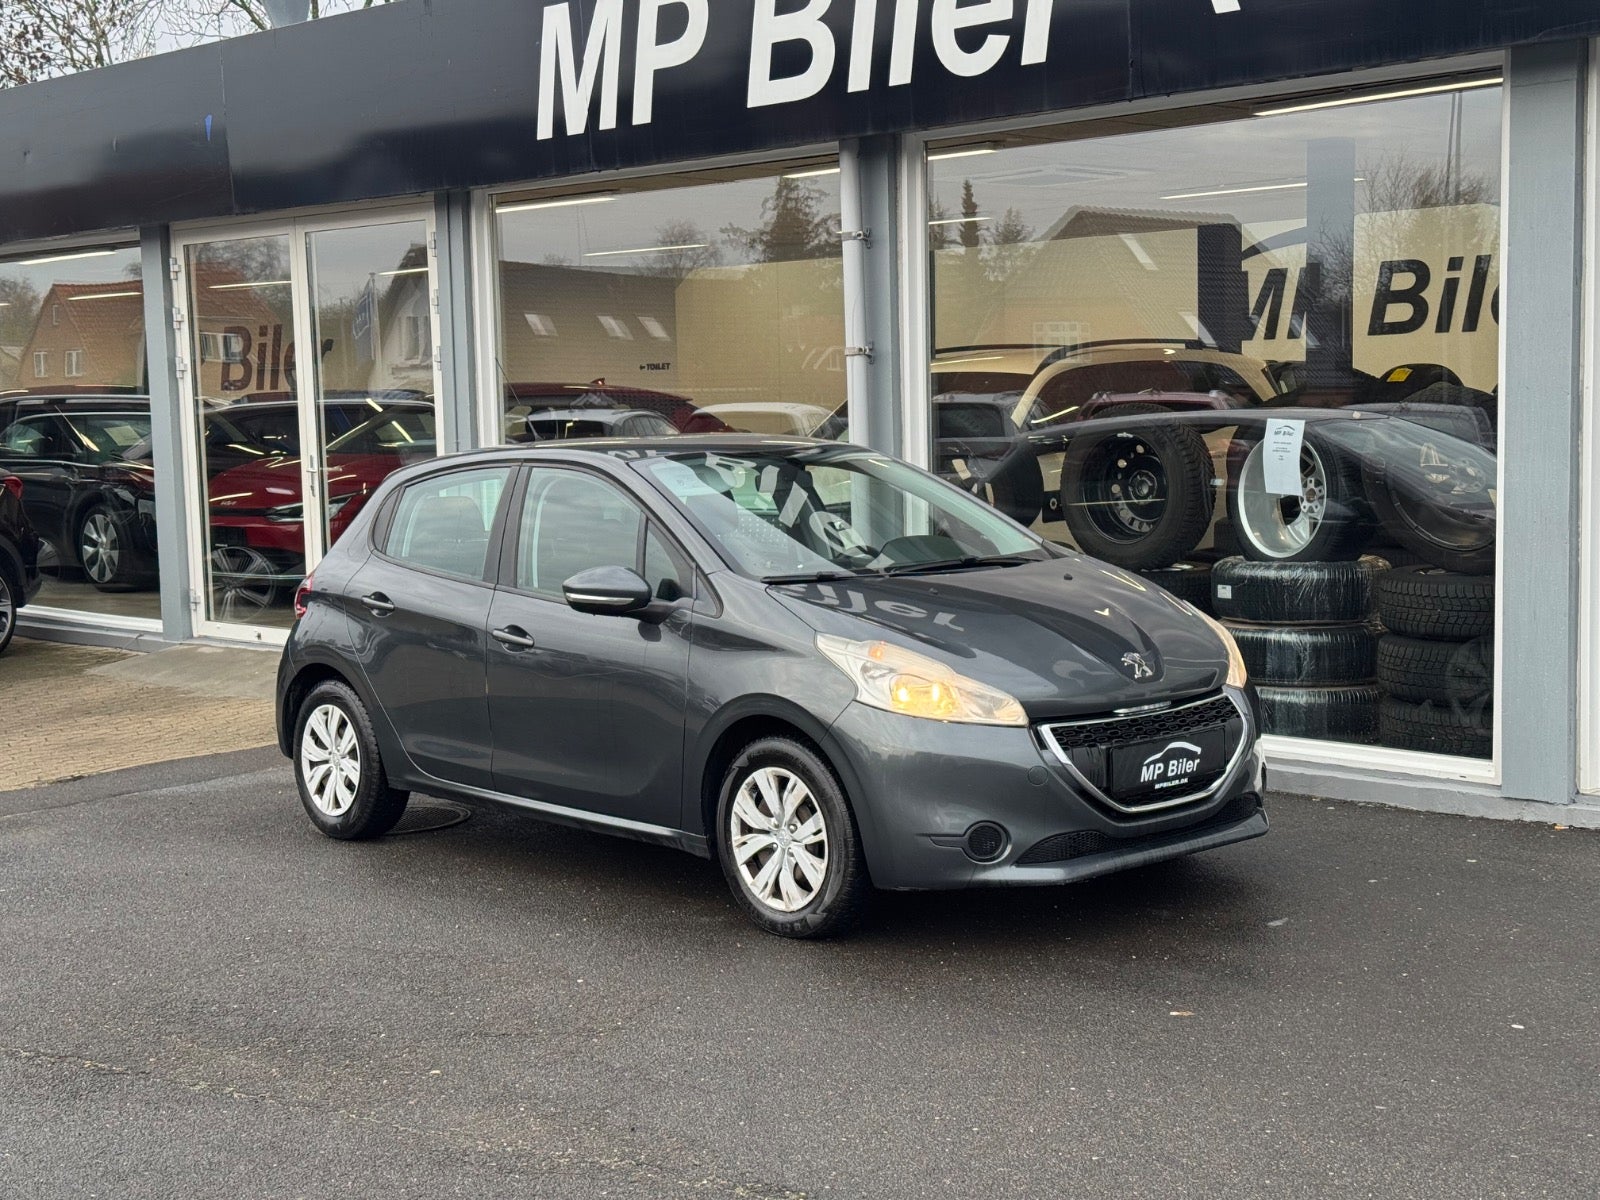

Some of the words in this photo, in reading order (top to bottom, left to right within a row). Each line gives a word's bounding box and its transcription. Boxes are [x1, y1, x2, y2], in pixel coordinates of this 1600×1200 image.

[537, 0, 708, 141] MP
[1368, 254, 1500, 337] Bil
[646, 362, 671, 370] TOILET
[1140, 762, 1164, 783] MP
[1167, 757, 1201, 777] Biler
